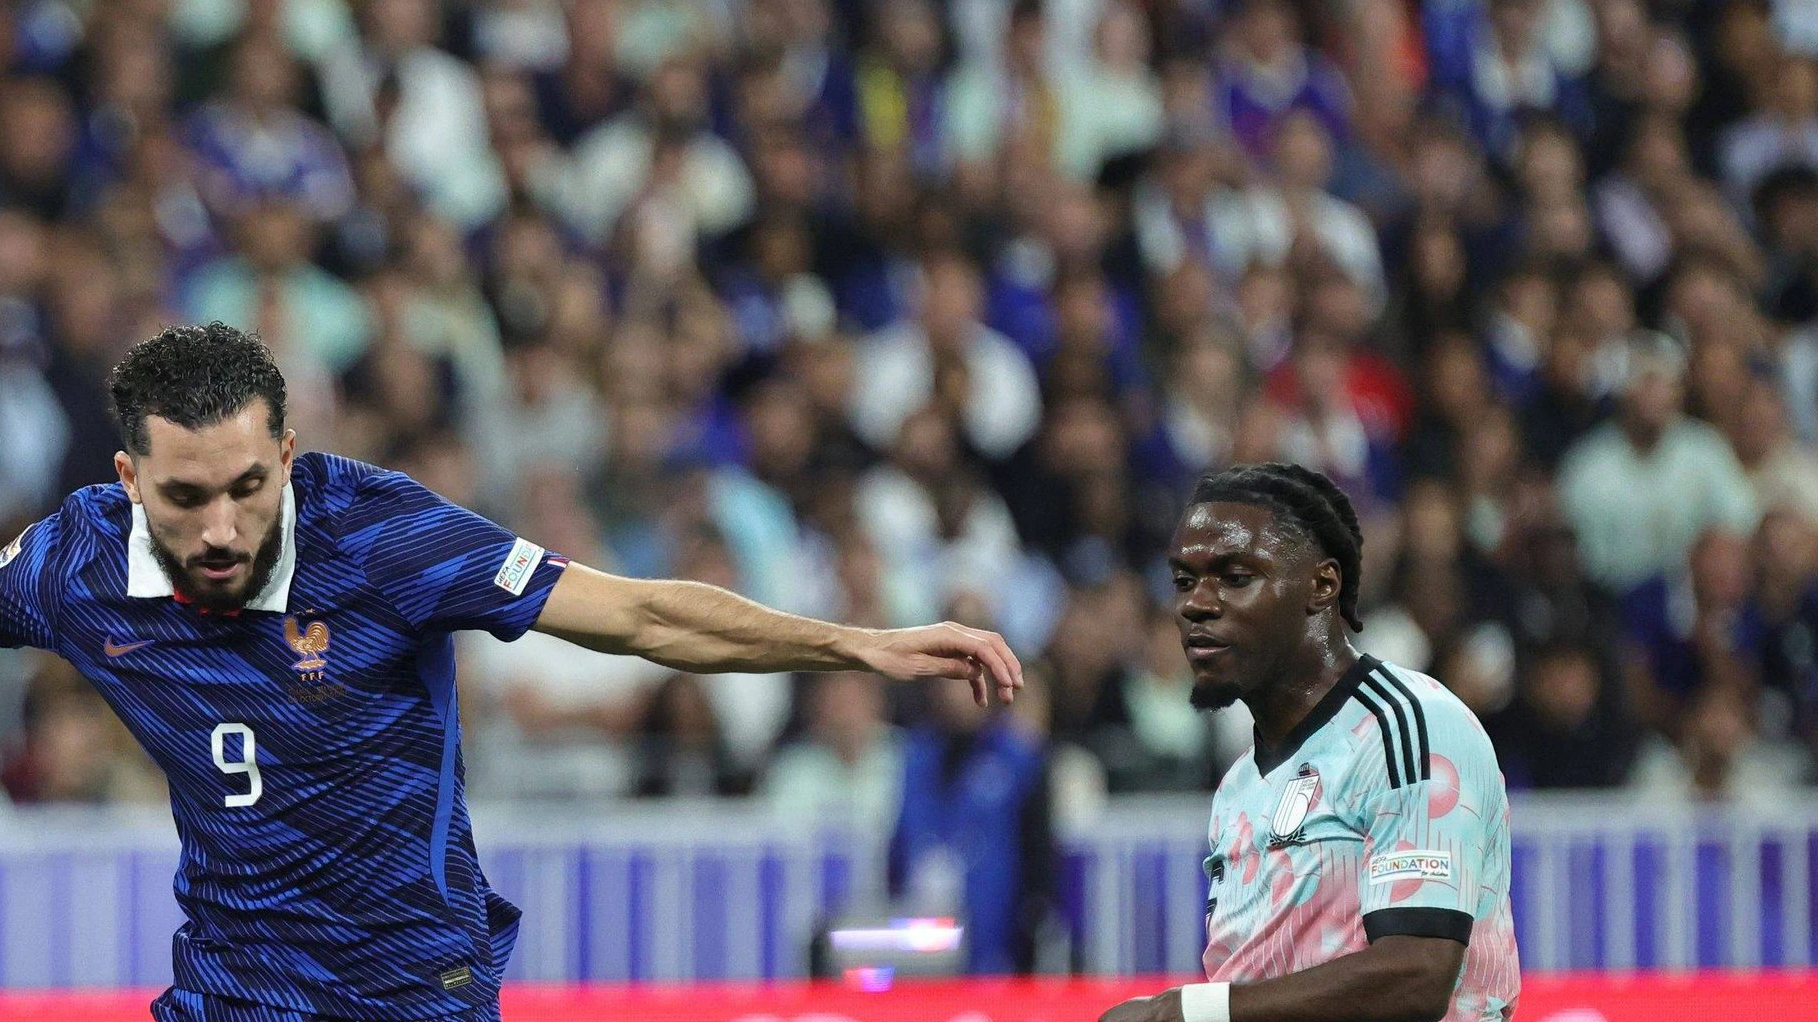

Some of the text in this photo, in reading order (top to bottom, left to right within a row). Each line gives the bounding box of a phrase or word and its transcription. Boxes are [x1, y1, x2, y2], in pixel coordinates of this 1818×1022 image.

[497, 565, 510, 584] UEFA
[503, 545, 533, 589] FOUND
[301, 672, 324, 681] FFF
[210, 722, 262, 808] 9
[1371, 858, 1449, 875] FOUNDATION
